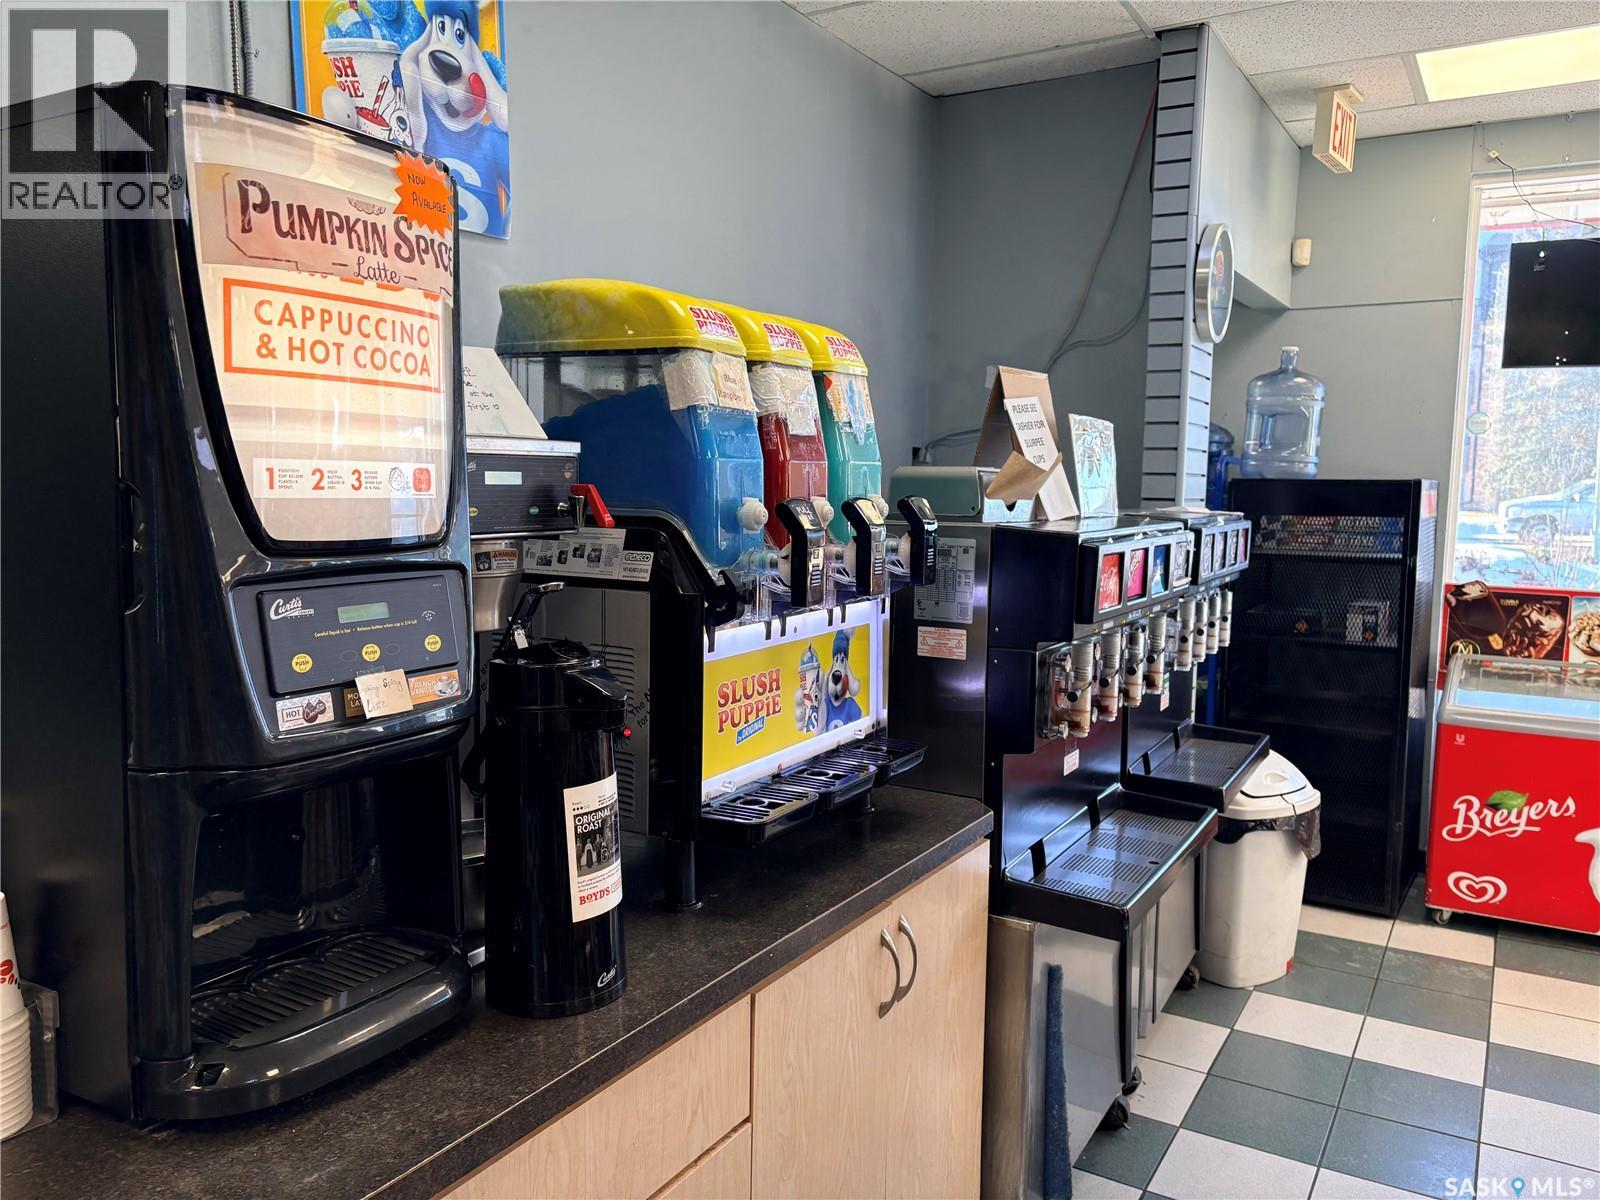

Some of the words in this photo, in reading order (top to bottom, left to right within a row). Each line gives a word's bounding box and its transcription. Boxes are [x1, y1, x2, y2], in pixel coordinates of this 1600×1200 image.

[1333, 101, 1354, 163] EXIT
[237, 179, 388, 258] PUMPKIN
[353, 256, 401, 284] Latte
[254, 299, 431, 349] CAPPUCCINO
[688, 306, 733, 325] SLUSH
[763, 323, 801, 340] SLUSH
[825, 336, 857, 351] SLUSH
[255, 333, 277, 360] &
[288, 336, 344, 366] HOT
[353, 345, 431, 377] COCOA
[1012, 403, 1029, 414] PLEASE
[1029, 403, 1038, 413] SEE
[1034, 419, 1046, 430] FOR
[1033, 454, 1046, 464] CUPS
[266, 467, 274, 490] 1
[311, 467, 325, 490] 2
[351, 469, 362, 491] 3
[270, 596, 302, 620] Curtis
[347, 692, 359, 700] MO
[717, 668, 781, 708] SLUSH
[285, 709, 300, 719] HOT
[575, 807, 611, 826] ORIGINAL
[577, 819, 602, 834] ROAST
[1442, 795, 1576, 842] Breyers
[578, 886, 611, 906] BOYD'S
[597, 965, 616, 987] Curtis
